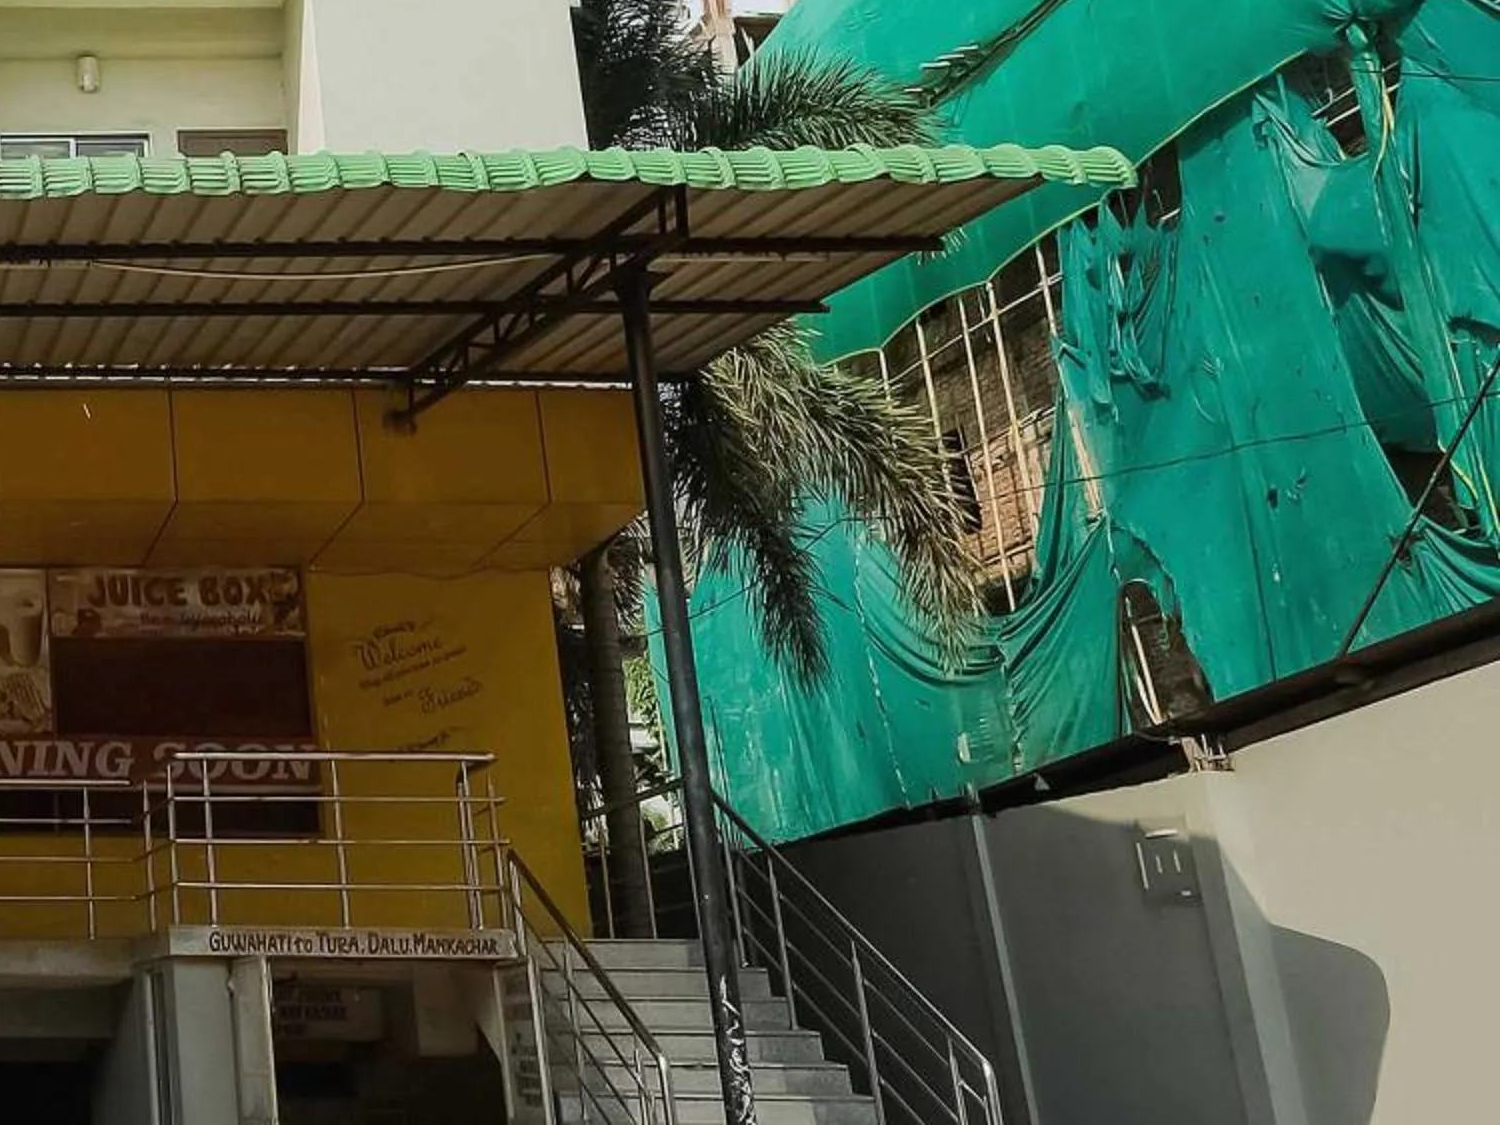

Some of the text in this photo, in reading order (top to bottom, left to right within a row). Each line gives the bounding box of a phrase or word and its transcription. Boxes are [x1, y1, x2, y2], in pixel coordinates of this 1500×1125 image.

[87, 575, 268, 607] JUICE BOX
[153, 741, 320, 781] SOON
[209, 931, 291, 953] GUWAHATI
